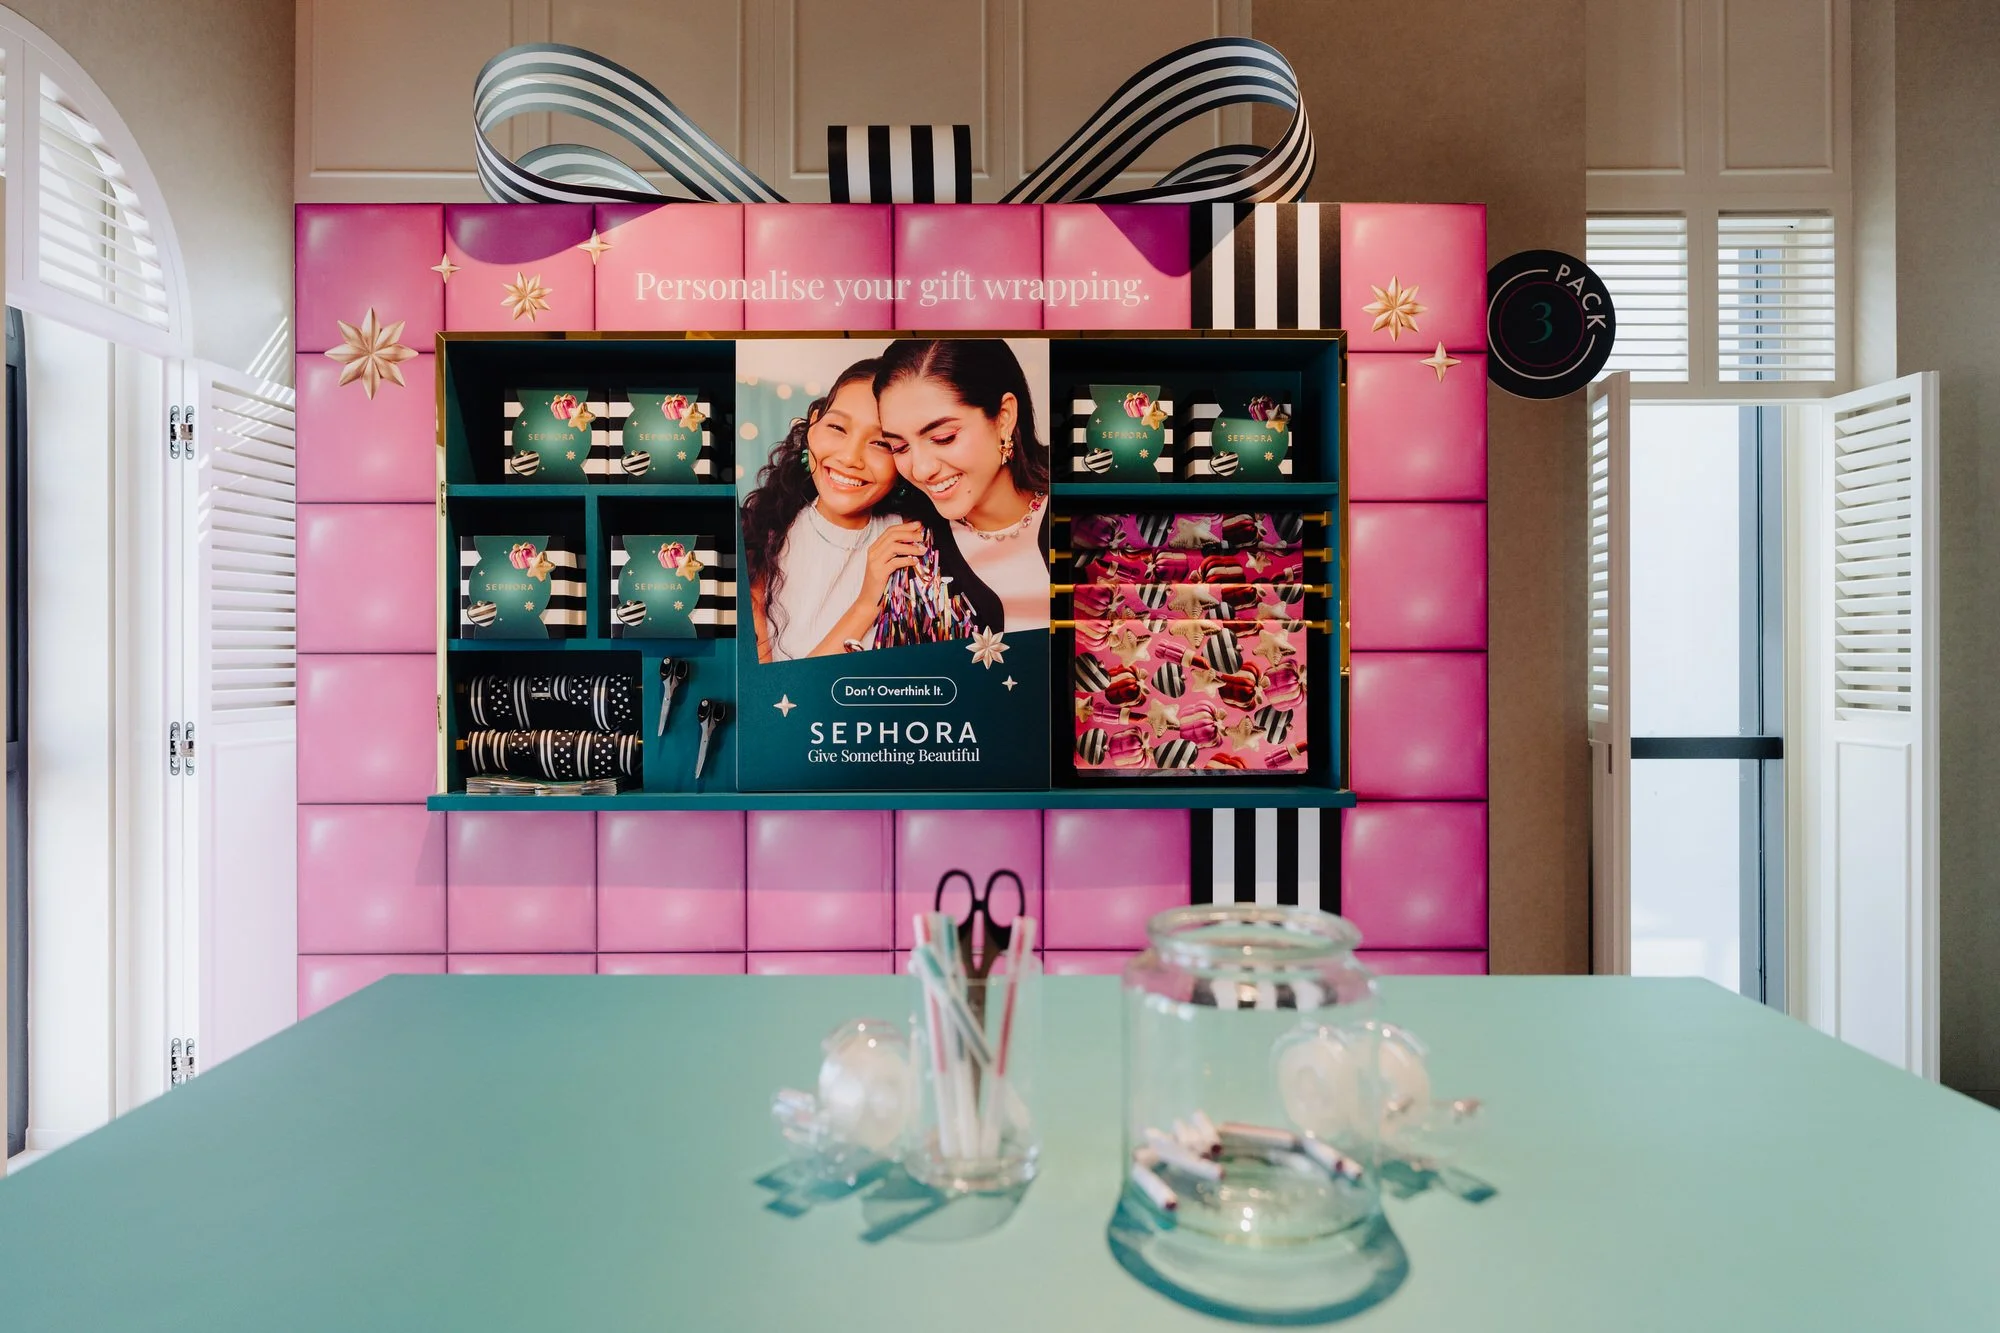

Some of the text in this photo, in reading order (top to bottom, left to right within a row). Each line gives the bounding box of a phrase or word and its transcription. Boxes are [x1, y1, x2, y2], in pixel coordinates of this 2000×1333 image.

[636, 270, 1150, 306] Personalise your gift wrapping.
[1555, 263, 1607, 330] PACK
[1528, 302, 1553, 344] 3
[528, 433, 575, 441] SEPHORA
[639, 433, 686, 441] SEPHORA
[1102, 431, 1148, 440] SEPHORA
[1227, 434, 1272, 443] SEPHORA
[485, 583, 534, 591] SEPHORA
[634, 582, 682, 591] SEPHORA
[877, 685, 930, 697] Overthink
[933, 685, 943, 697] It.
[810, 721, 977, 745] SEPHORA
[808, 748, 980, 765] Give Something Beautiful
